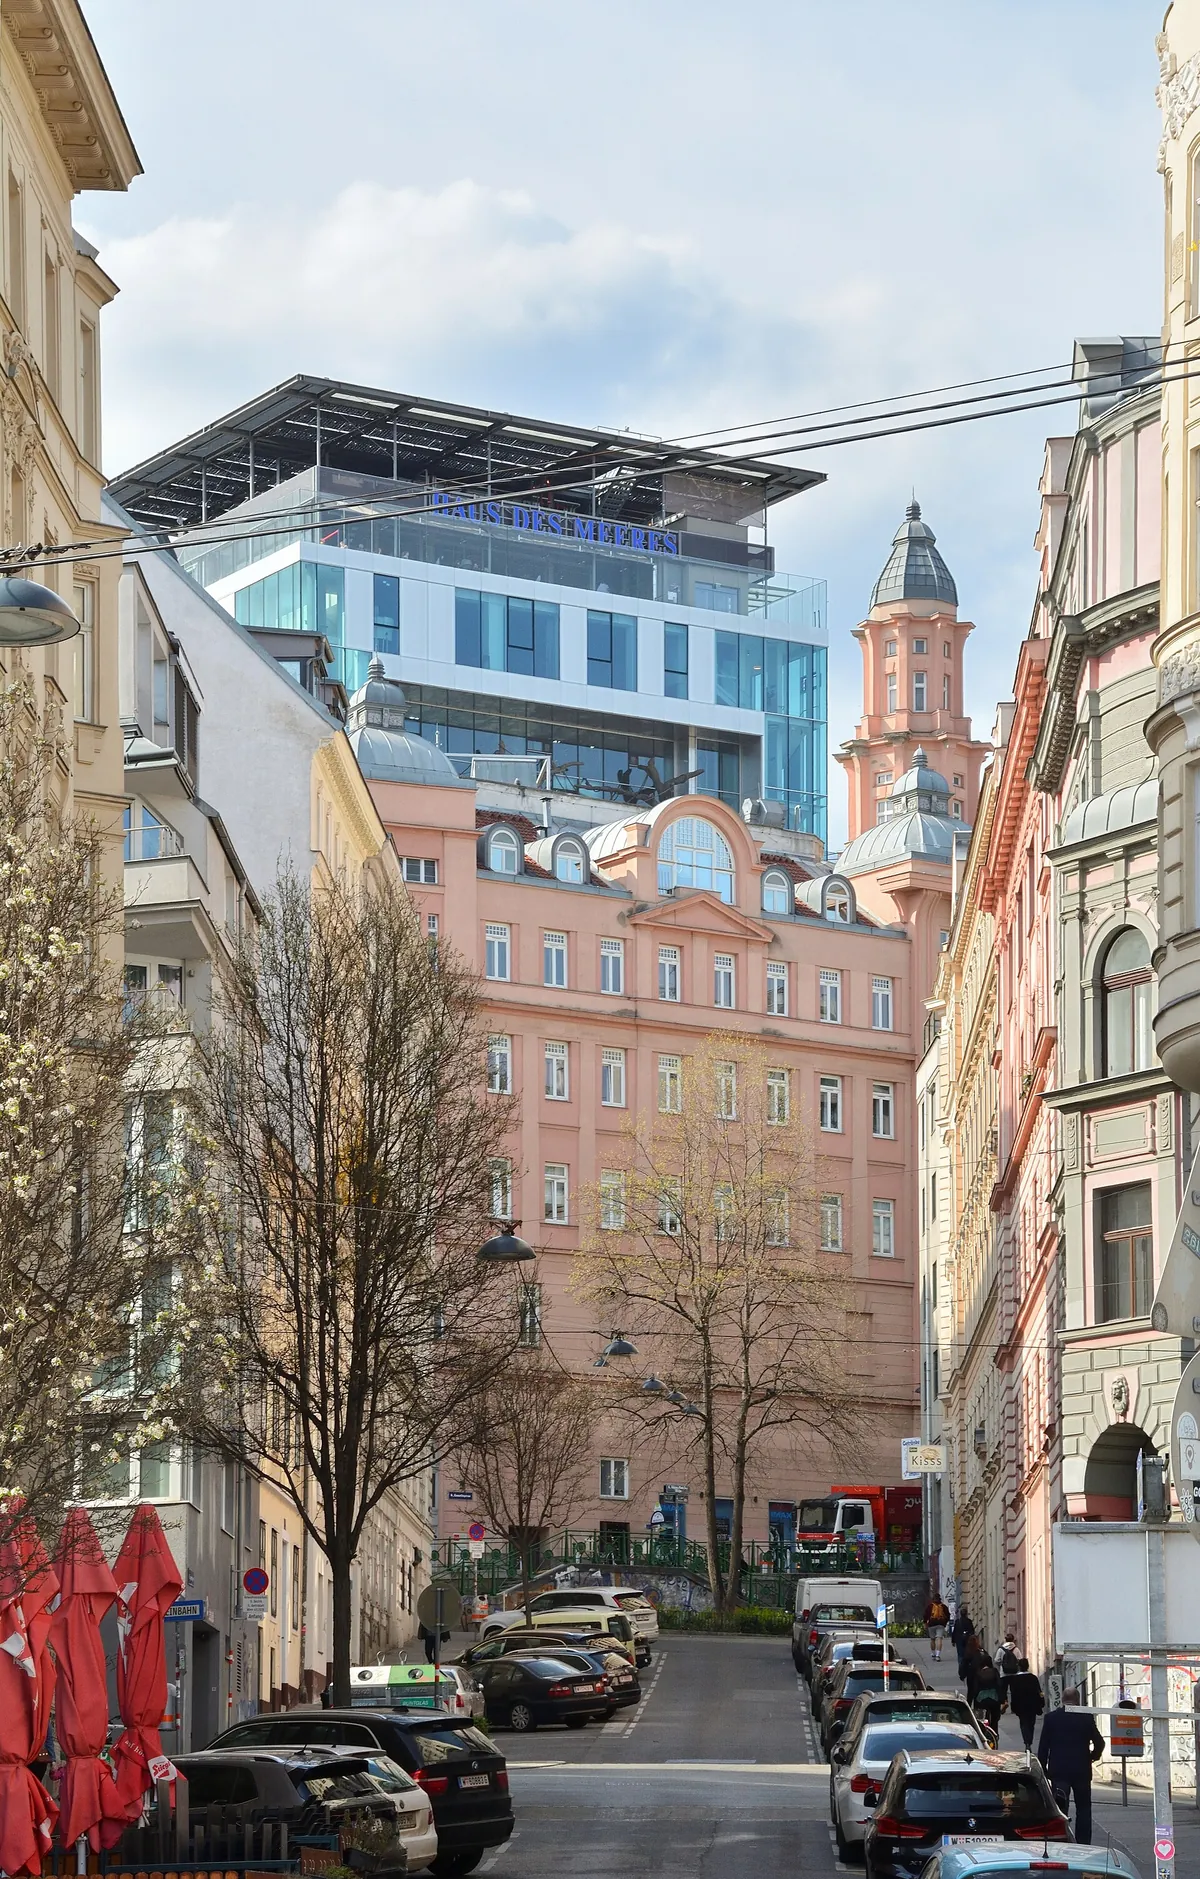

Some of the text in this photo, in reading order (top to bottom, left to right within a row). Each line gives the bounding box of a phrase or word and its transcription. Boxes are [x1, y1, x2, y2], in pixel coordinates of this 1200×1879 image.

[432, 492, 678, 557] HAUS DES MEERES
[911, 1455, 942, 1466] Kisss
